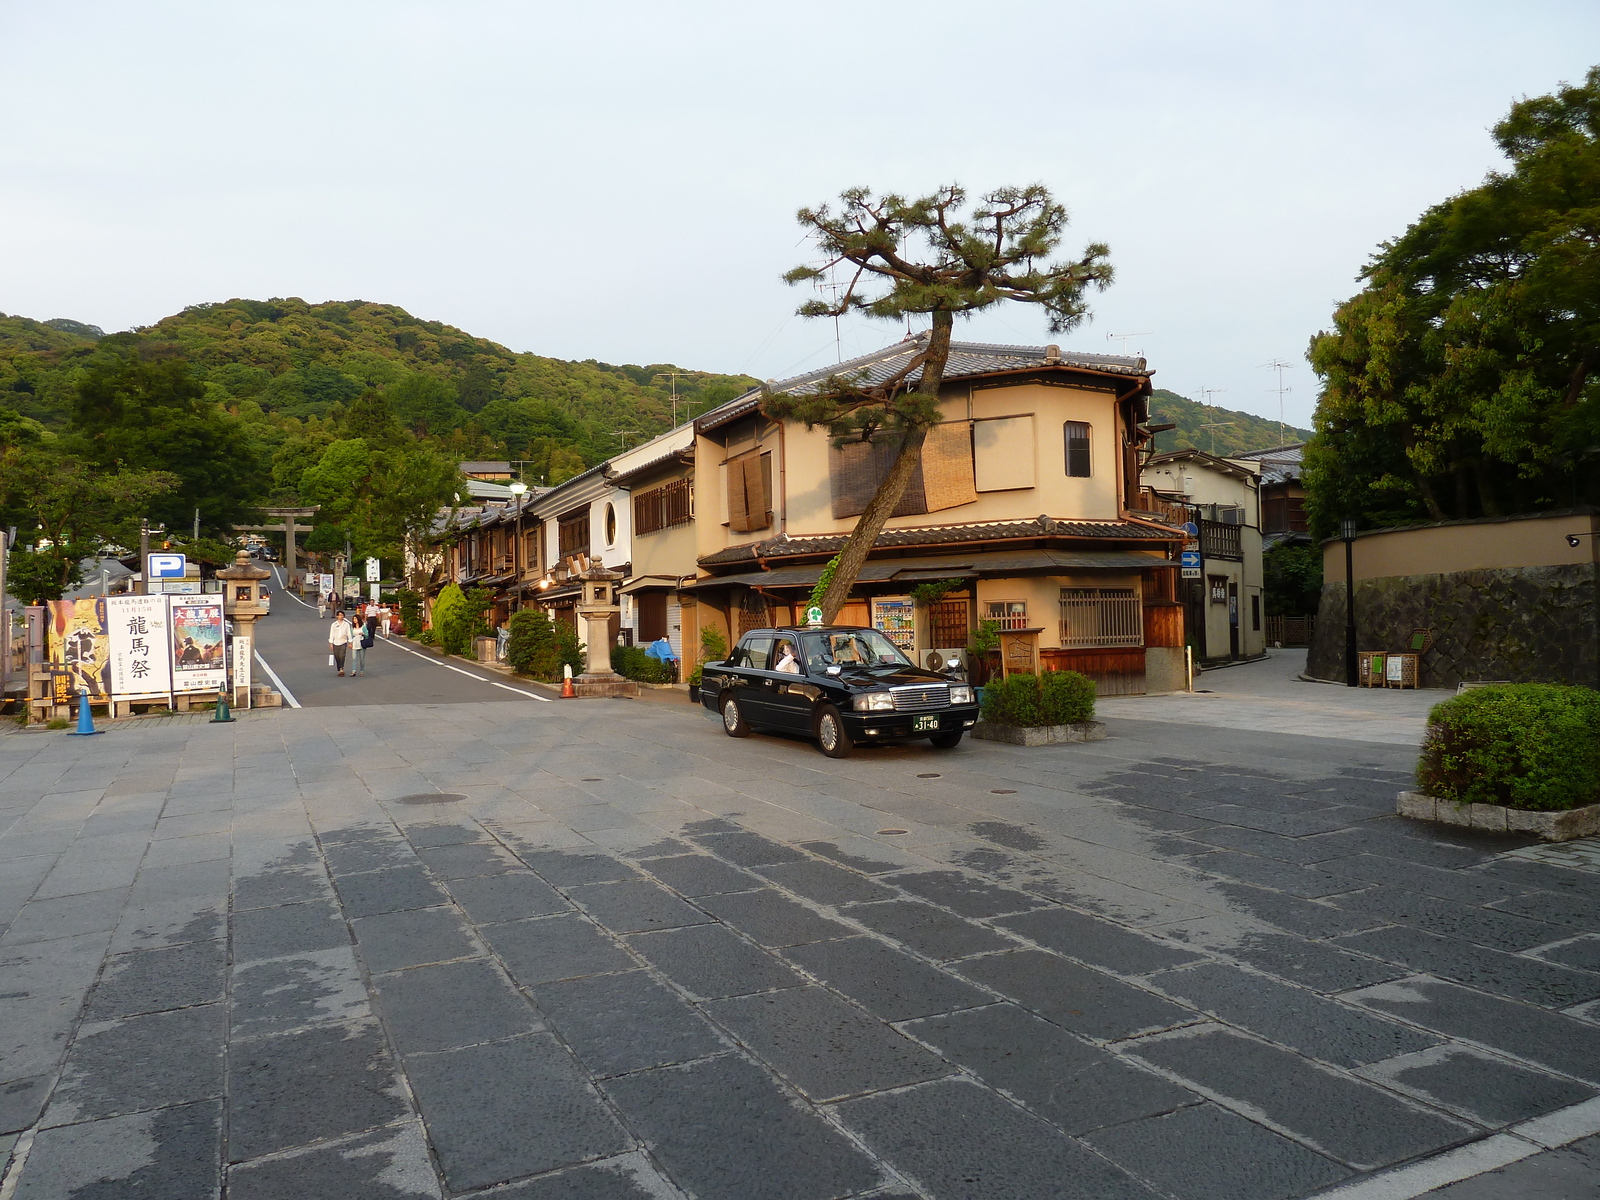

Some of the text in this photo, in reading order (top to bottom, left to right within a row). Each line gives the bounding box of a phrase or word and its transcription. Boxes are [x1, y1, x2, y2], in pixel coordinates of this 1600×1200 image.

[152, 557, 182, 577] P
[175, 608, 221, 619] 大龍馬展
[126, 616, 152, 679] 龍馬祭
